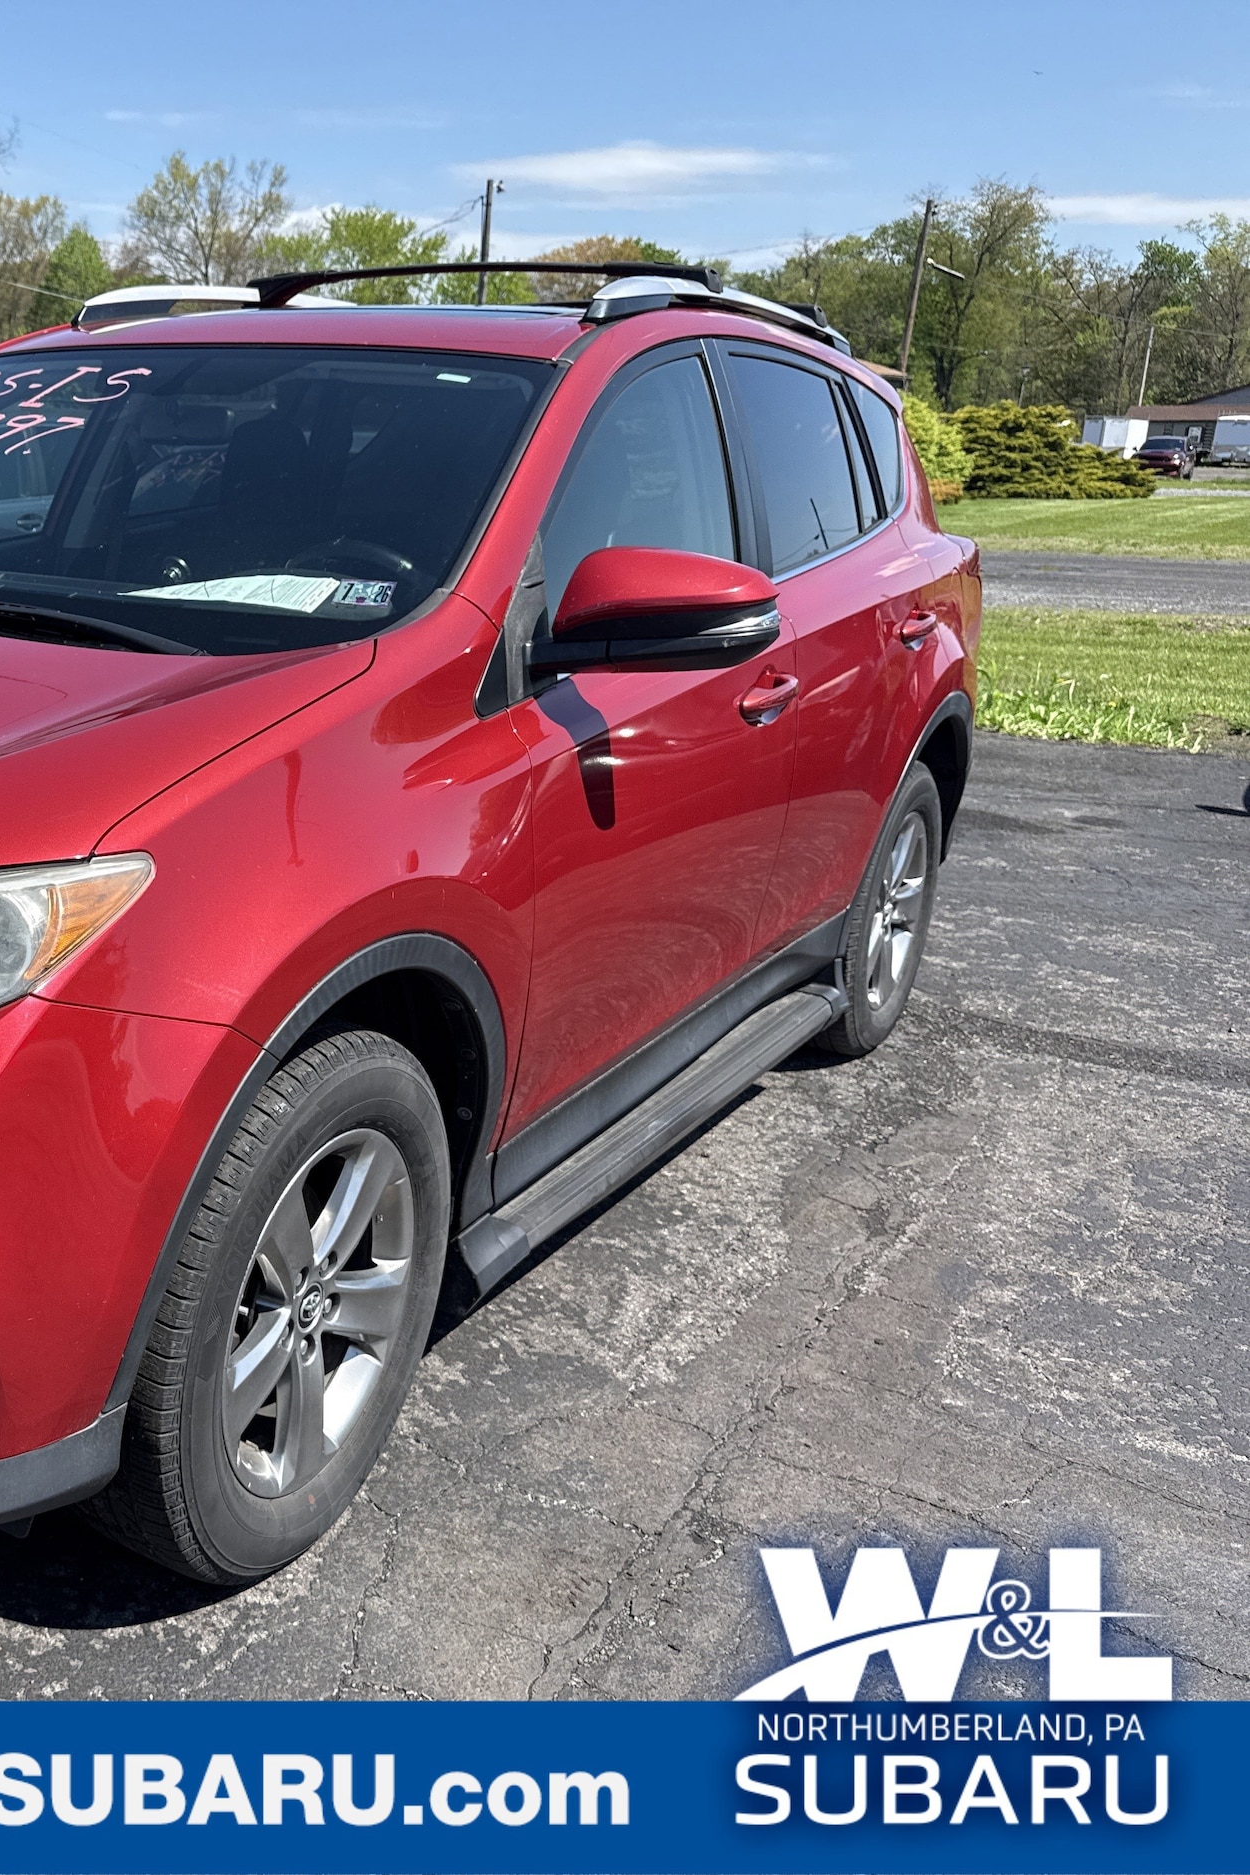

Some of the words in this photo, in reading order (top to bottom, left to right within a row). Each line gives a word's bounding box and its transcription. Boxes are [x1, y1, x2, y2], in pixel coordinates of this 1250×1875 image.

[341, 582, 355, 601] 7
[373, 585, 392, 603] 26
[216, 1131, 309, 1298] YOKOHAMA
